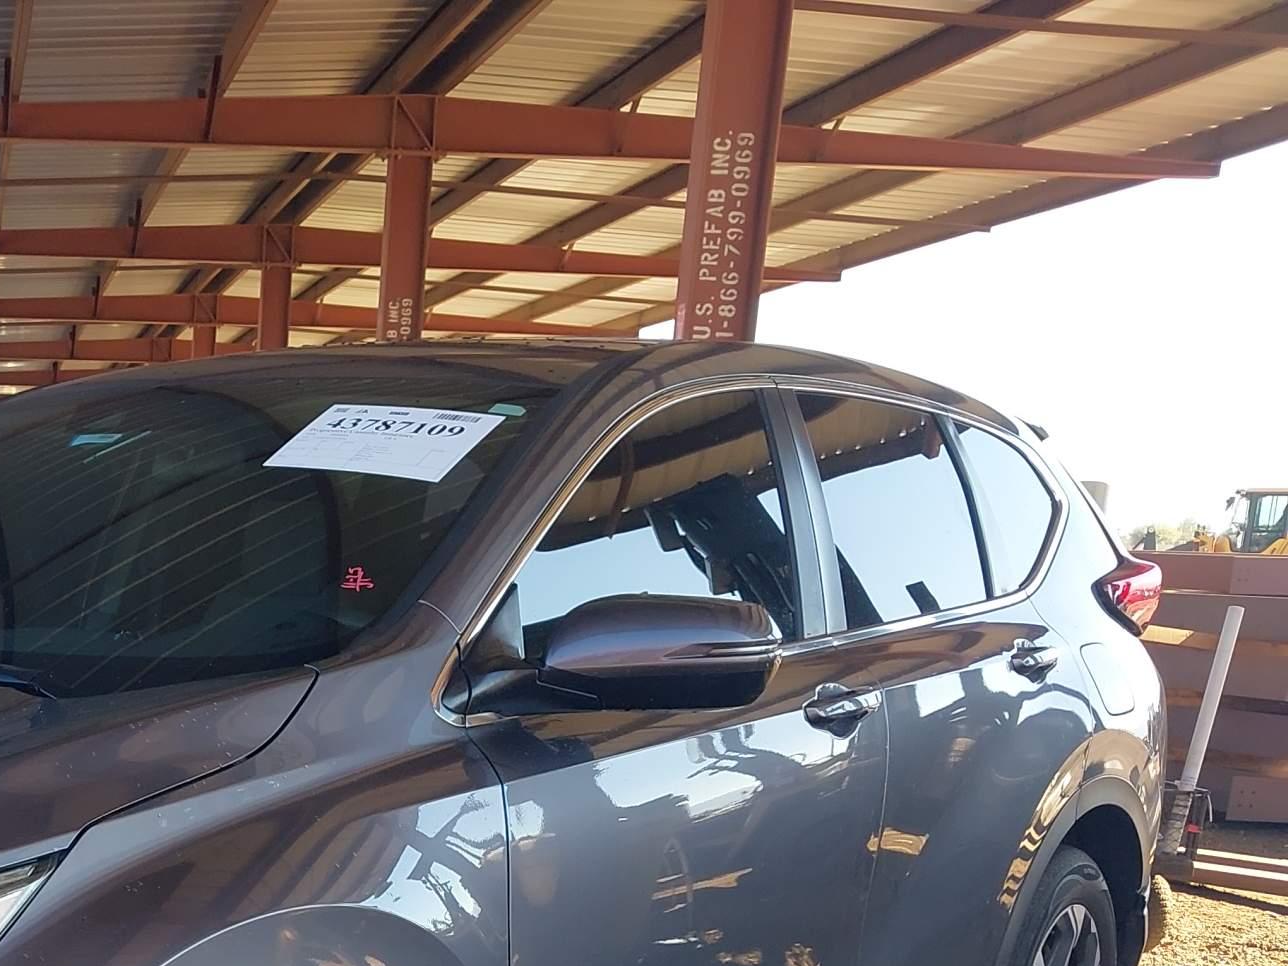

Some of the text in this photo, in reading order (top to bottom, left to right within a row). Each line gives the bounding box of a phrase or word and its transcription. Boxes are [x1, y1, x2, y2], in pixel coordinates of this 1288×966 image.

[692, 130, 733, 339] U.S. PREFAB INC.
[715, 132, 755, 338] 1-866-799-0969
[326, 417, 466, 437] 43787109
